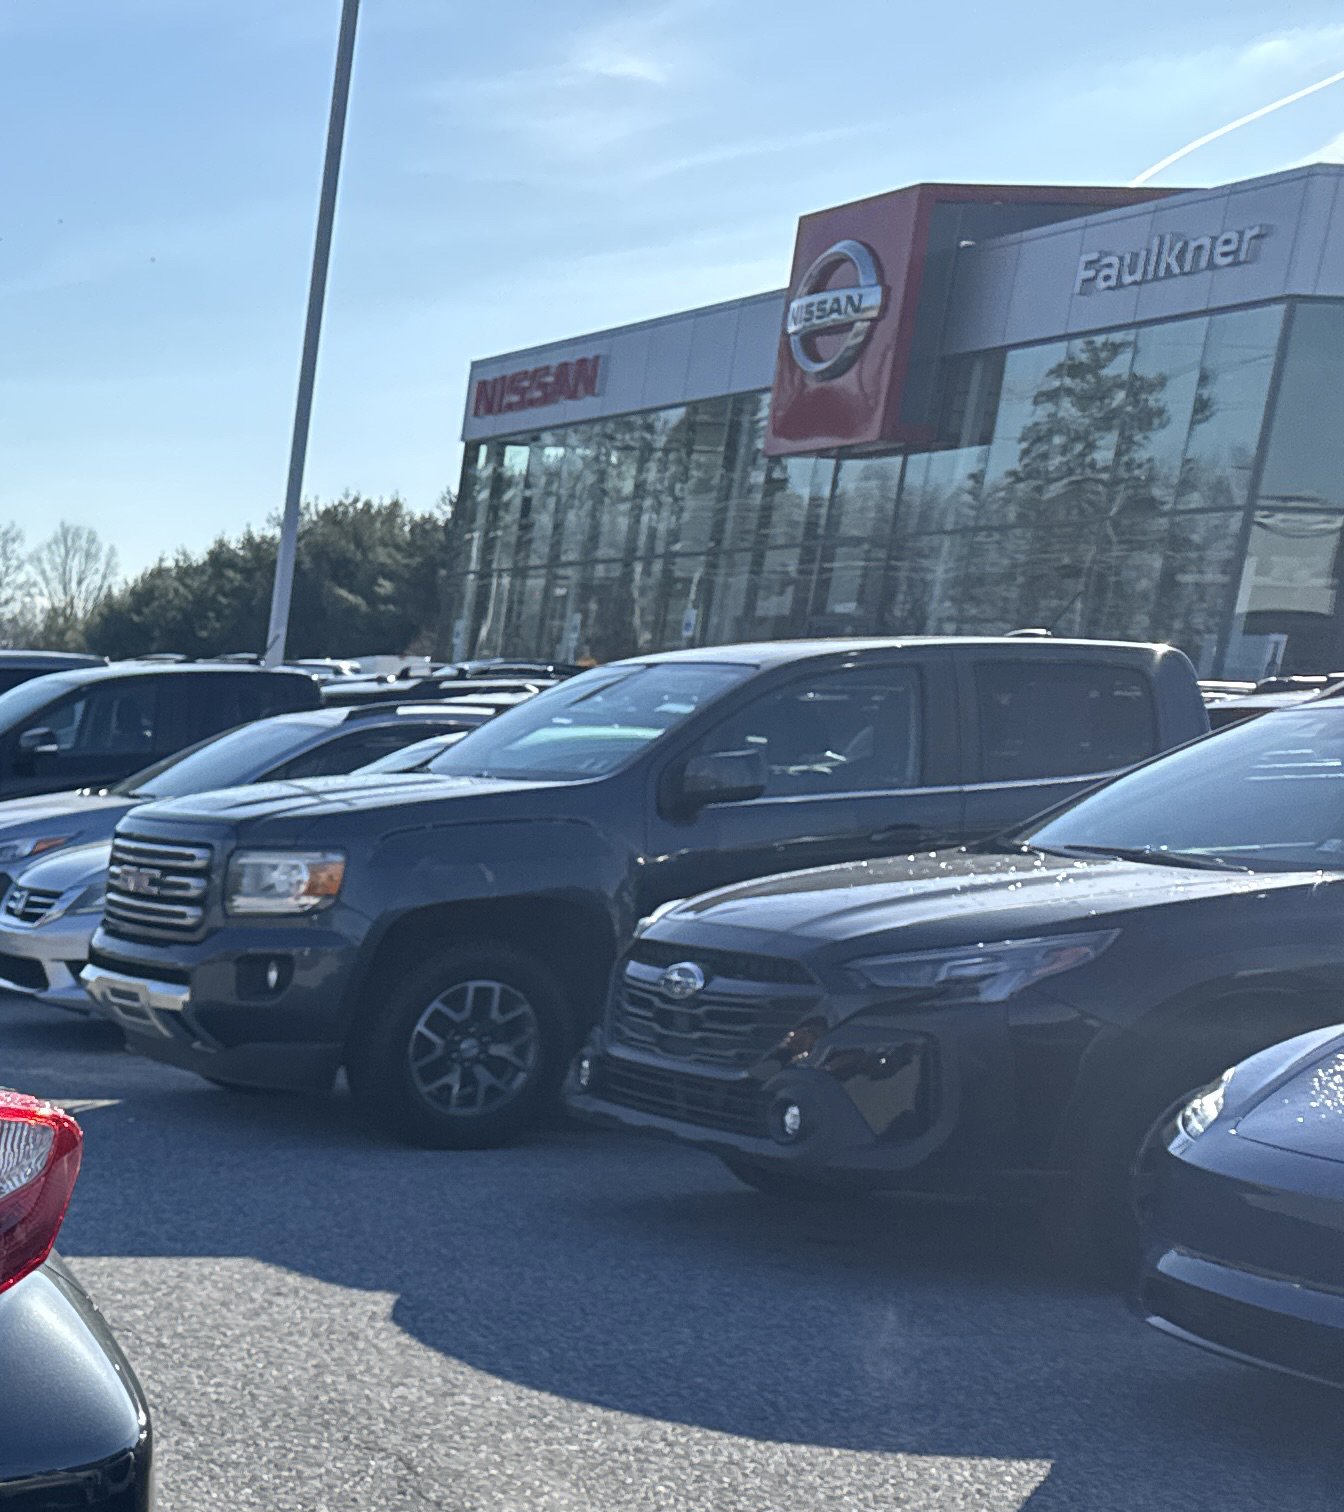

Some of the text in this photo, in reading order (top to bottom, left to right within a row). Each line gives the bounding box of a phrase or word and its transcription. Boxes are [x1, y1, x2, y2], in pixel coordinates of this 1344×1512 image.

[1074, 225, 1261, 295] Faulkner
[792, 293, 864, 326] NISSAN
[473, 354, 601, 417] NISSAN
